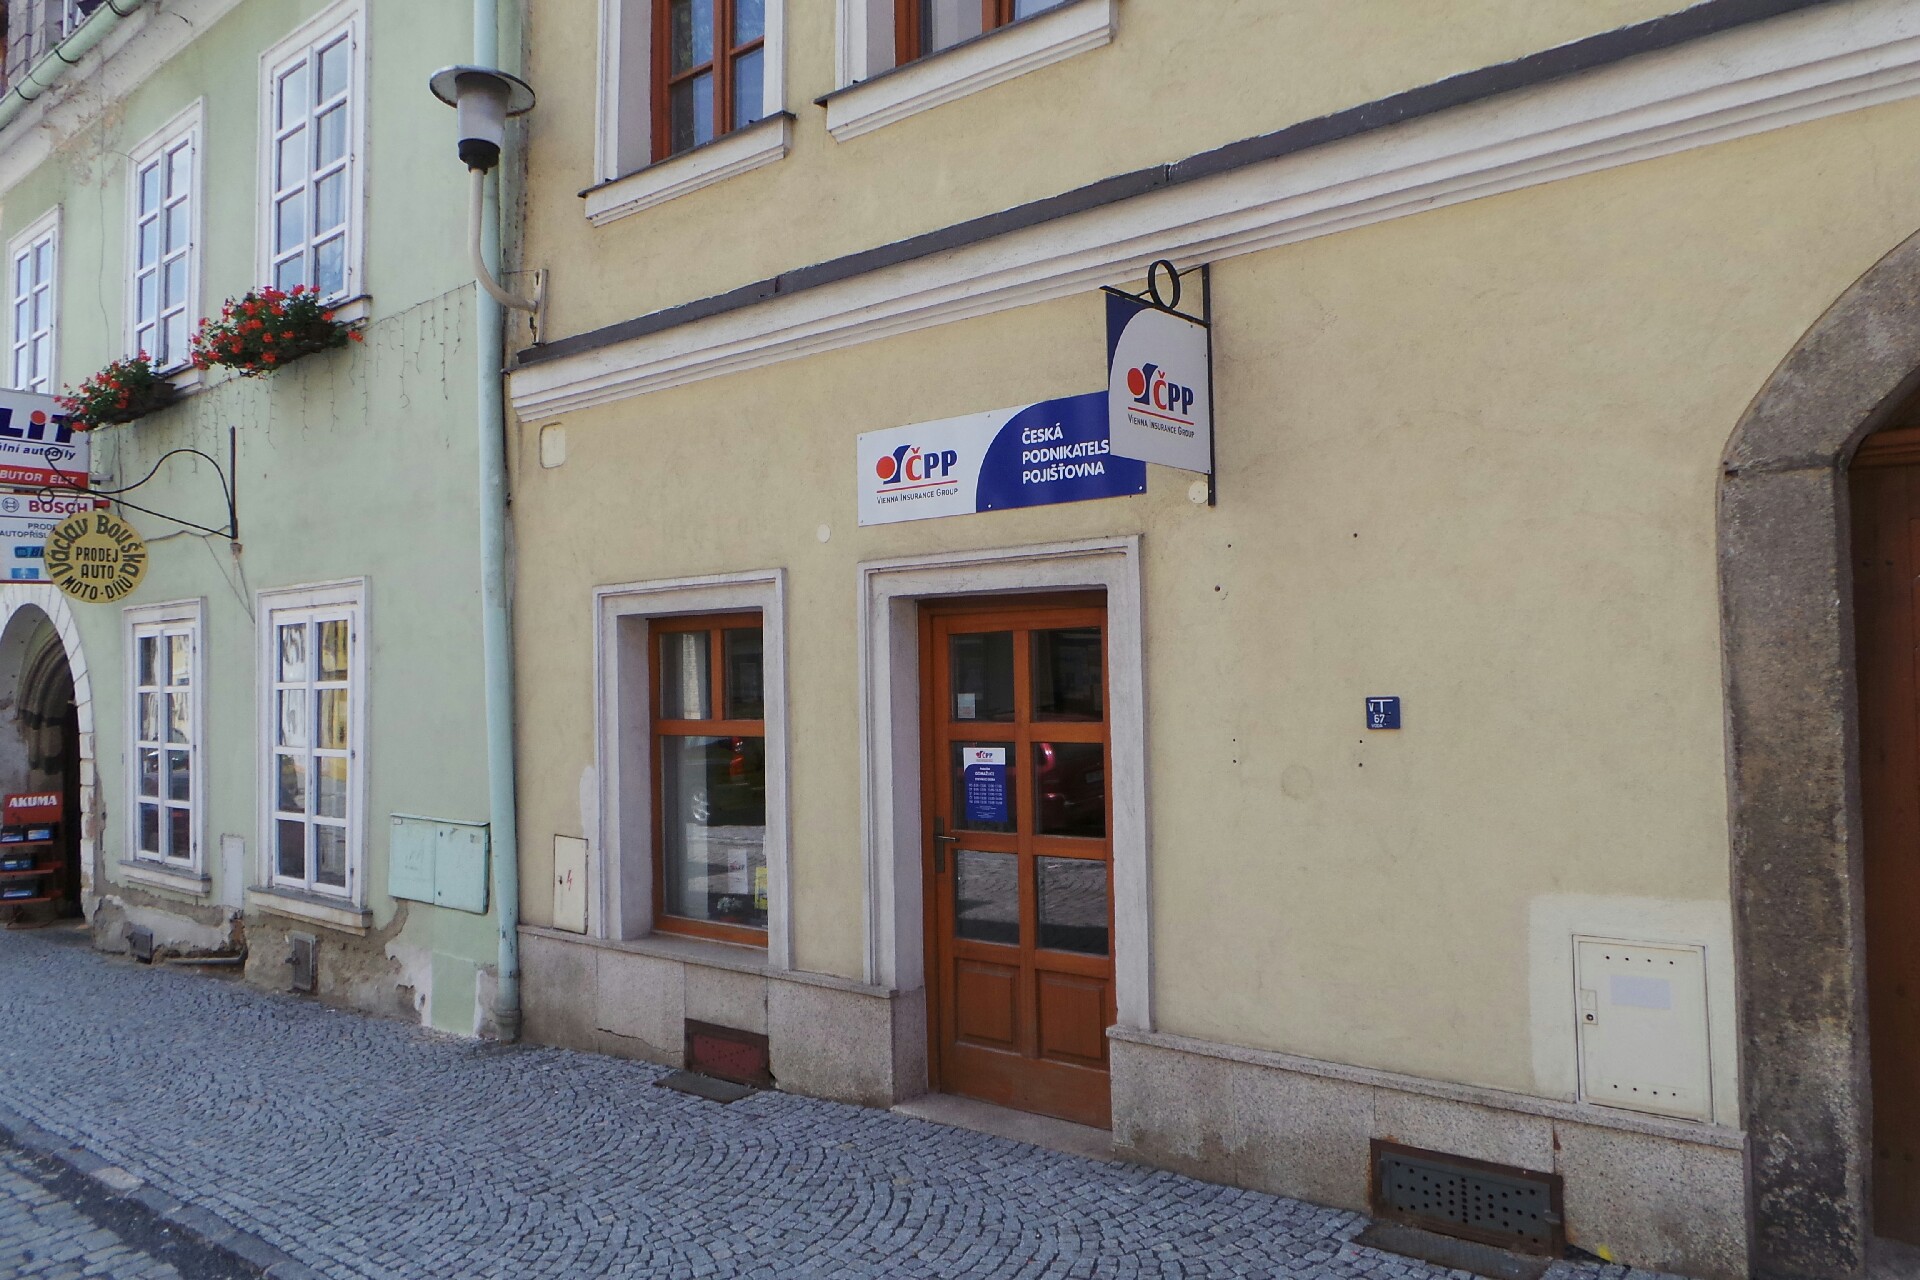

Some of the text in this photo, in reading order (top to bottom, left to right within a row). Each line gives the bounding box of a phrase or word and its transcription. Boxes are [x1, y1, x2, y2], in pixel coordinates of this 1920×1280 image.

[1153, 370, 1194, 415] ČPP
[1022, 422, 1063, 444] ČESKÁ
[1022, 439, 1110, 465] PODNIKATELS
[905, 446, 958, 481] ČPP
[1022, 461, 1105, 485] POJIŠŤOVNA
[29, 500, 88, 513] BOSCH
[76, 547, 118, 563] PRODEJ
[81, 563, 114, 579] AUTO
[1374, 714, 1384, 723] 67
[9, 795, 57, 808] AKUMA
